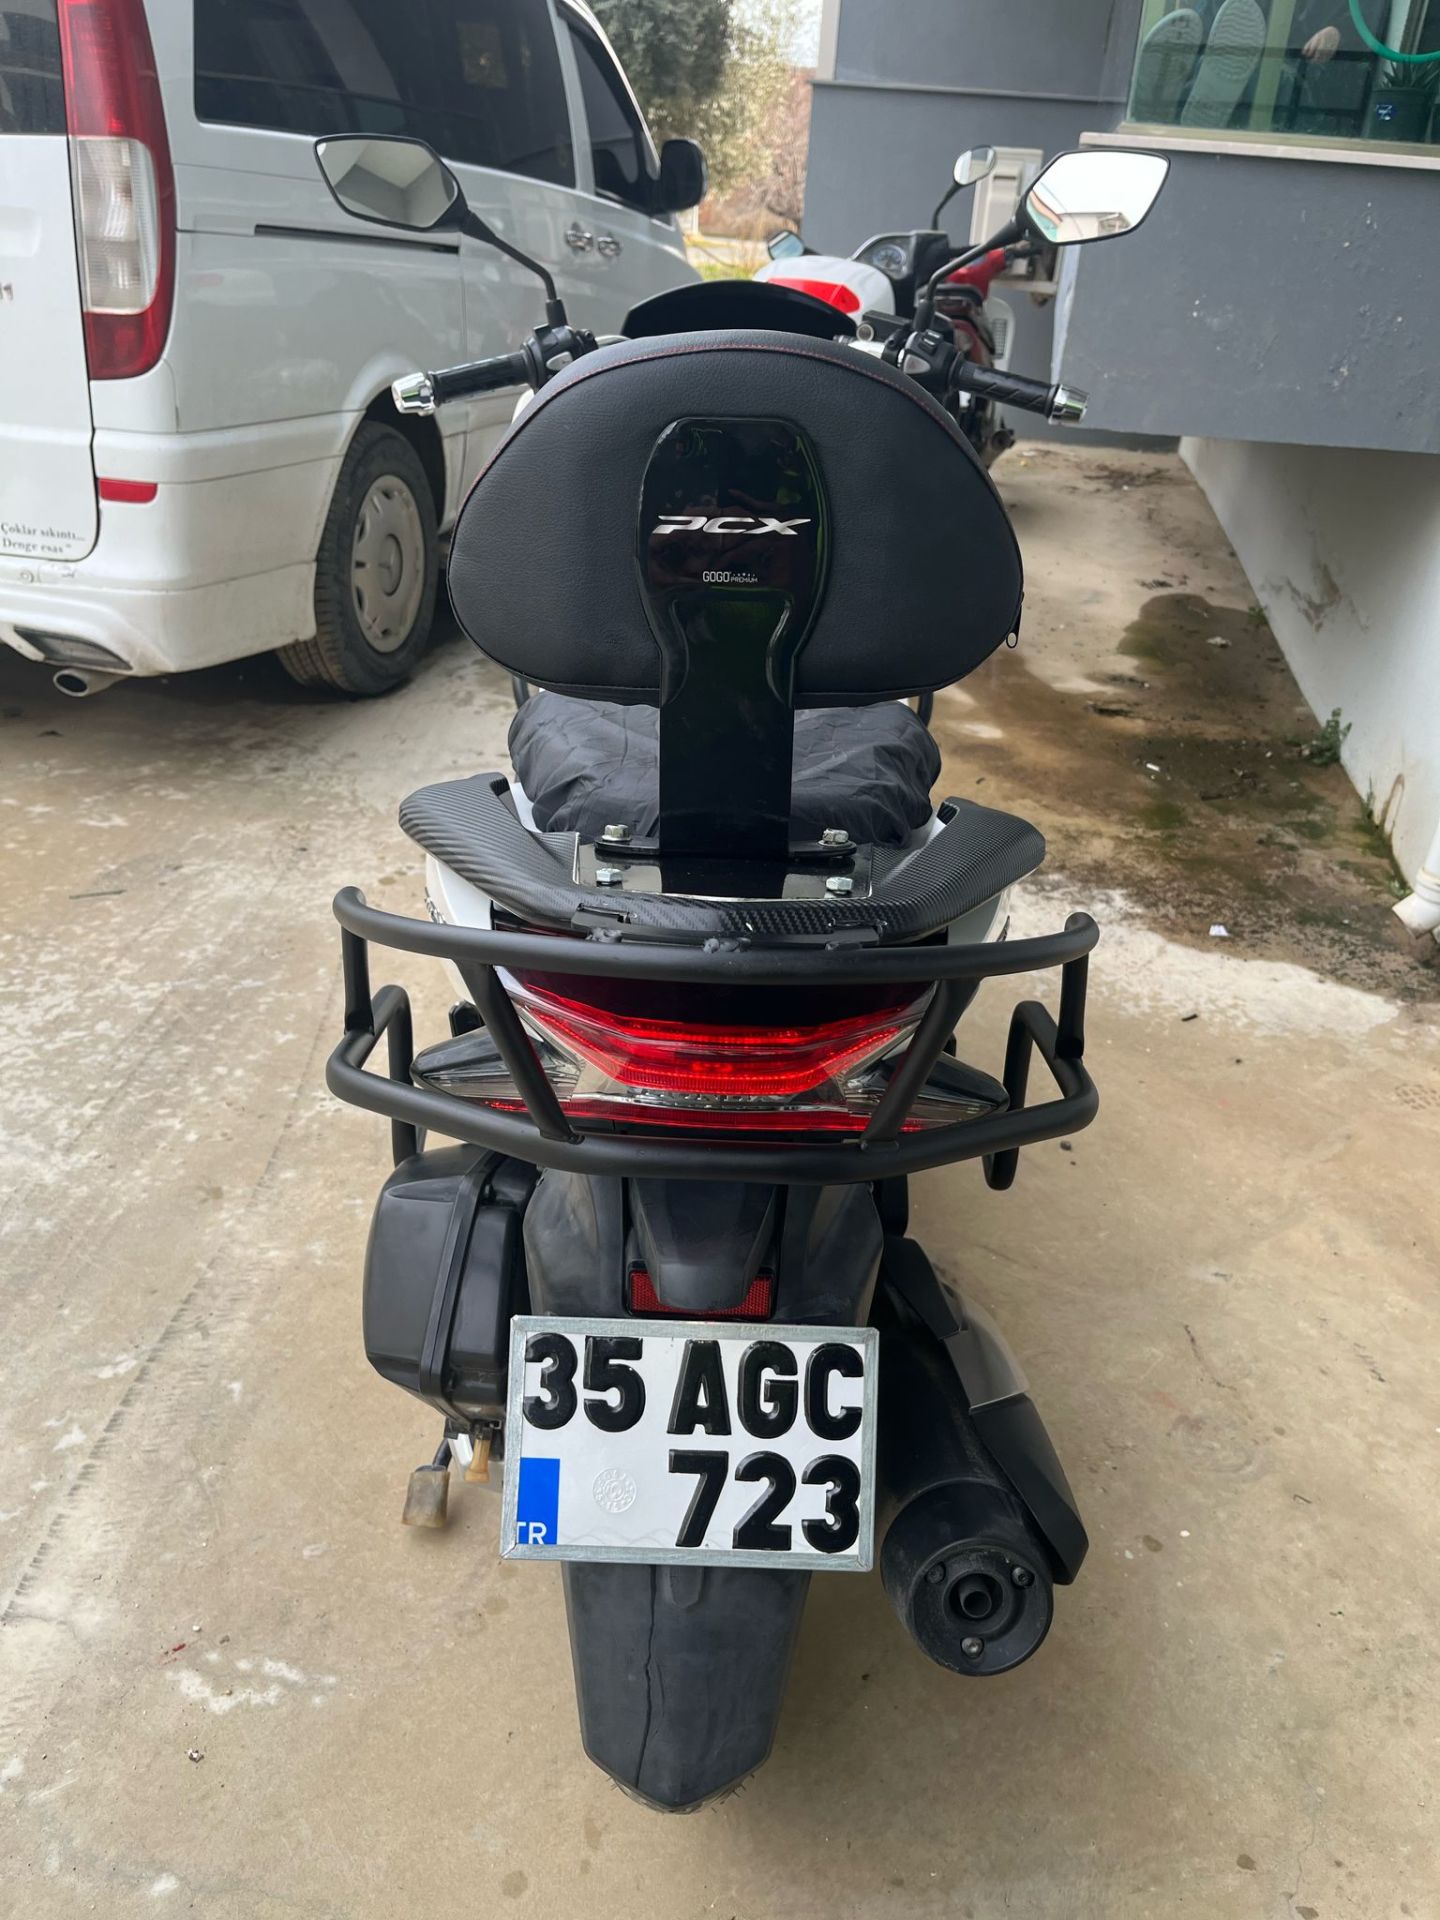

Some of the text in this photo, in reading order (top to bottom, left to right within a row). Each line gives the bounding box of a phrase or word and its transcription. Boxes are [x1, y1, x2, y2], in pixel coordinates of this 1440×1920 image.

[652, 515, 811, 535] PCX
[3, 537, 37, 552] Denge
[703, 571, 730, 582] GOGO
[523, 1332, 864, 1440] 35 AGC
[669, 1449, 861, 1553] 723
